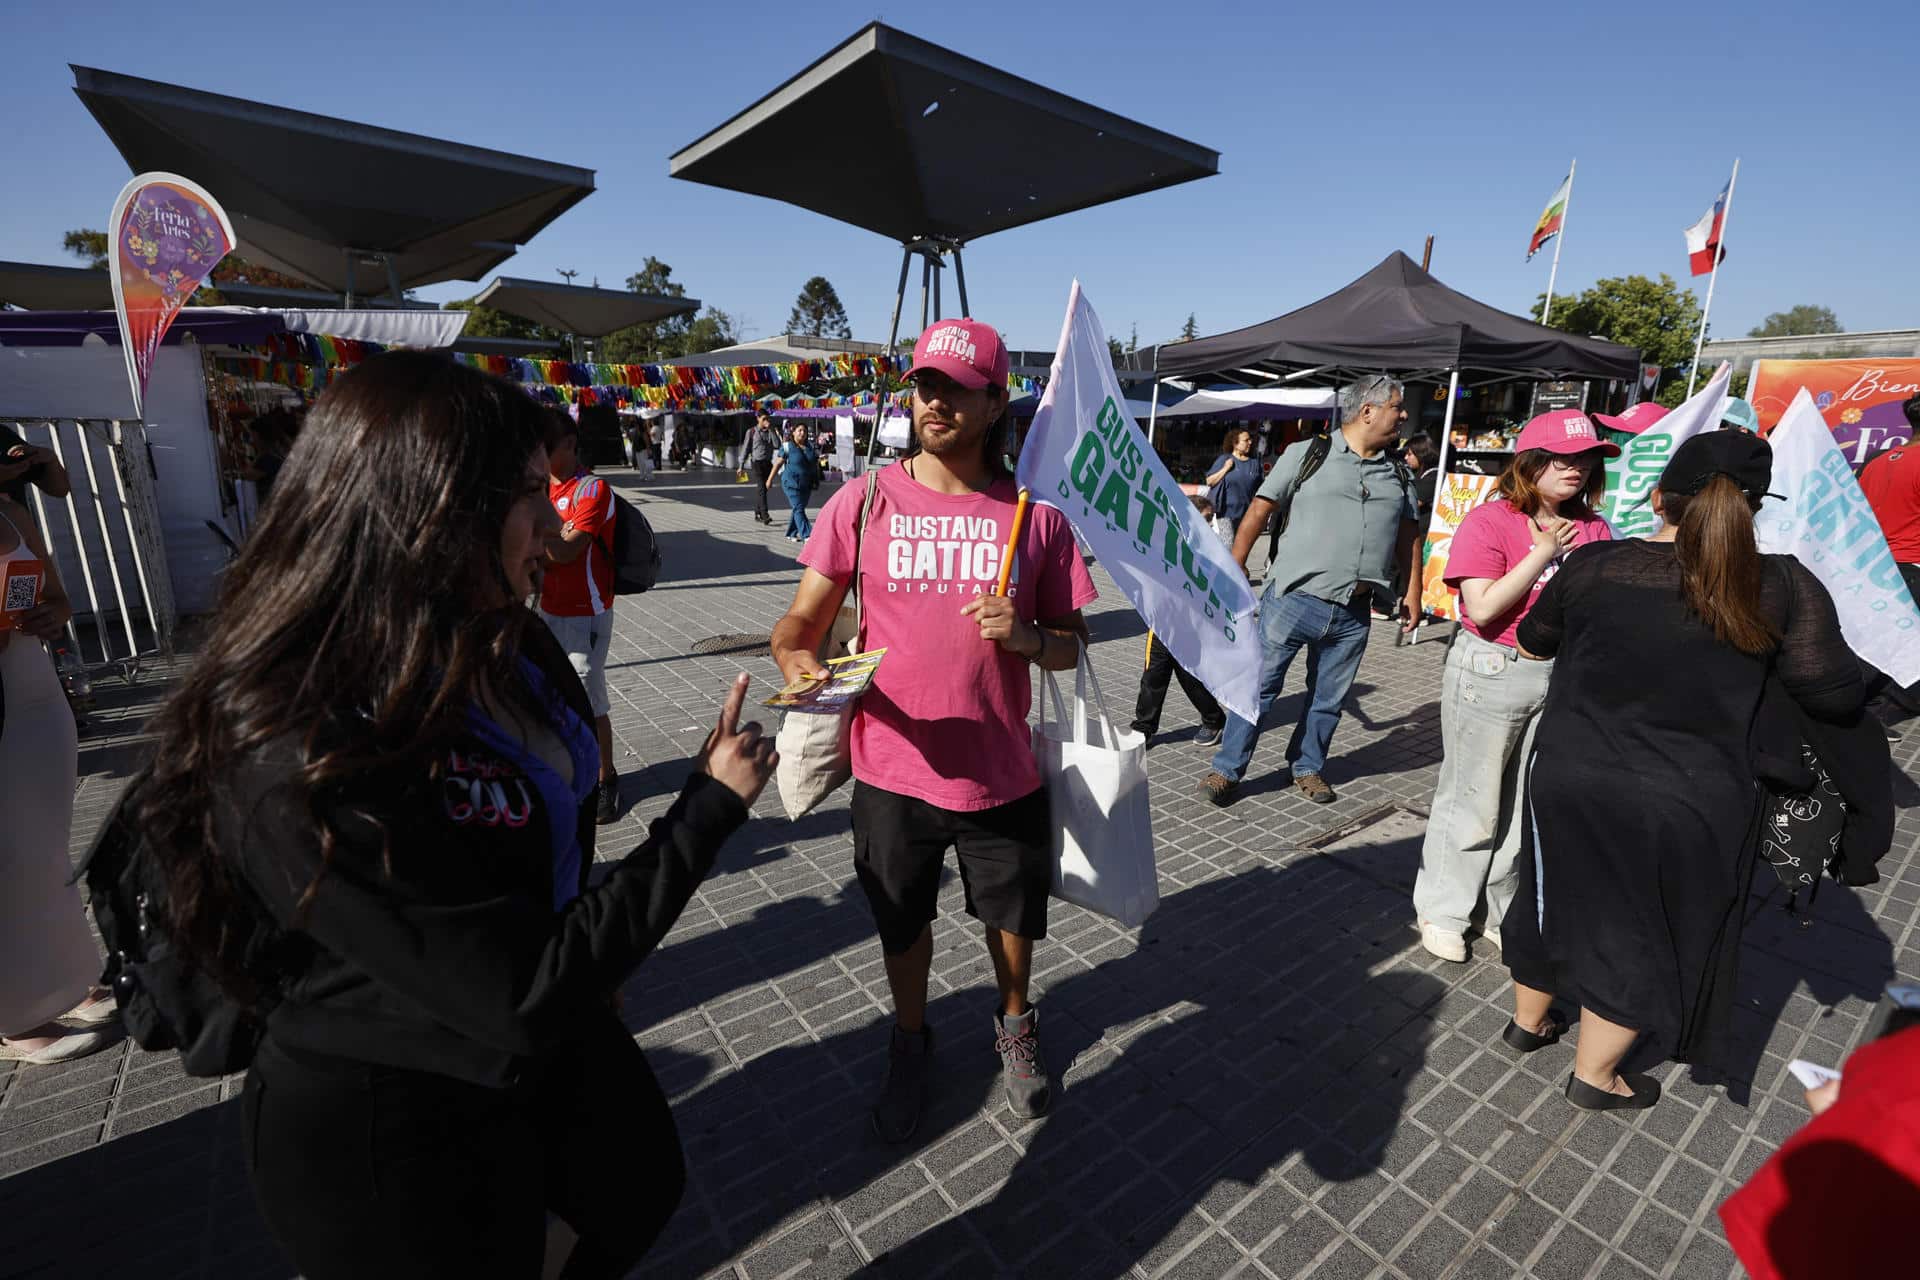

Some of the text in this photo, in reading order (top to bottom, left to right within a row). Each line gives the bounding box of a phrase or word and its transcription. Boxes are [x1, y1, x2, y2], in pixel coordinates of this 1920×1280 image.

[931, 326, 970, 341] GUSTAVO
[926, 334, 976, 361] GATICA
[890, 513, 997, 541] GUSTAVO
